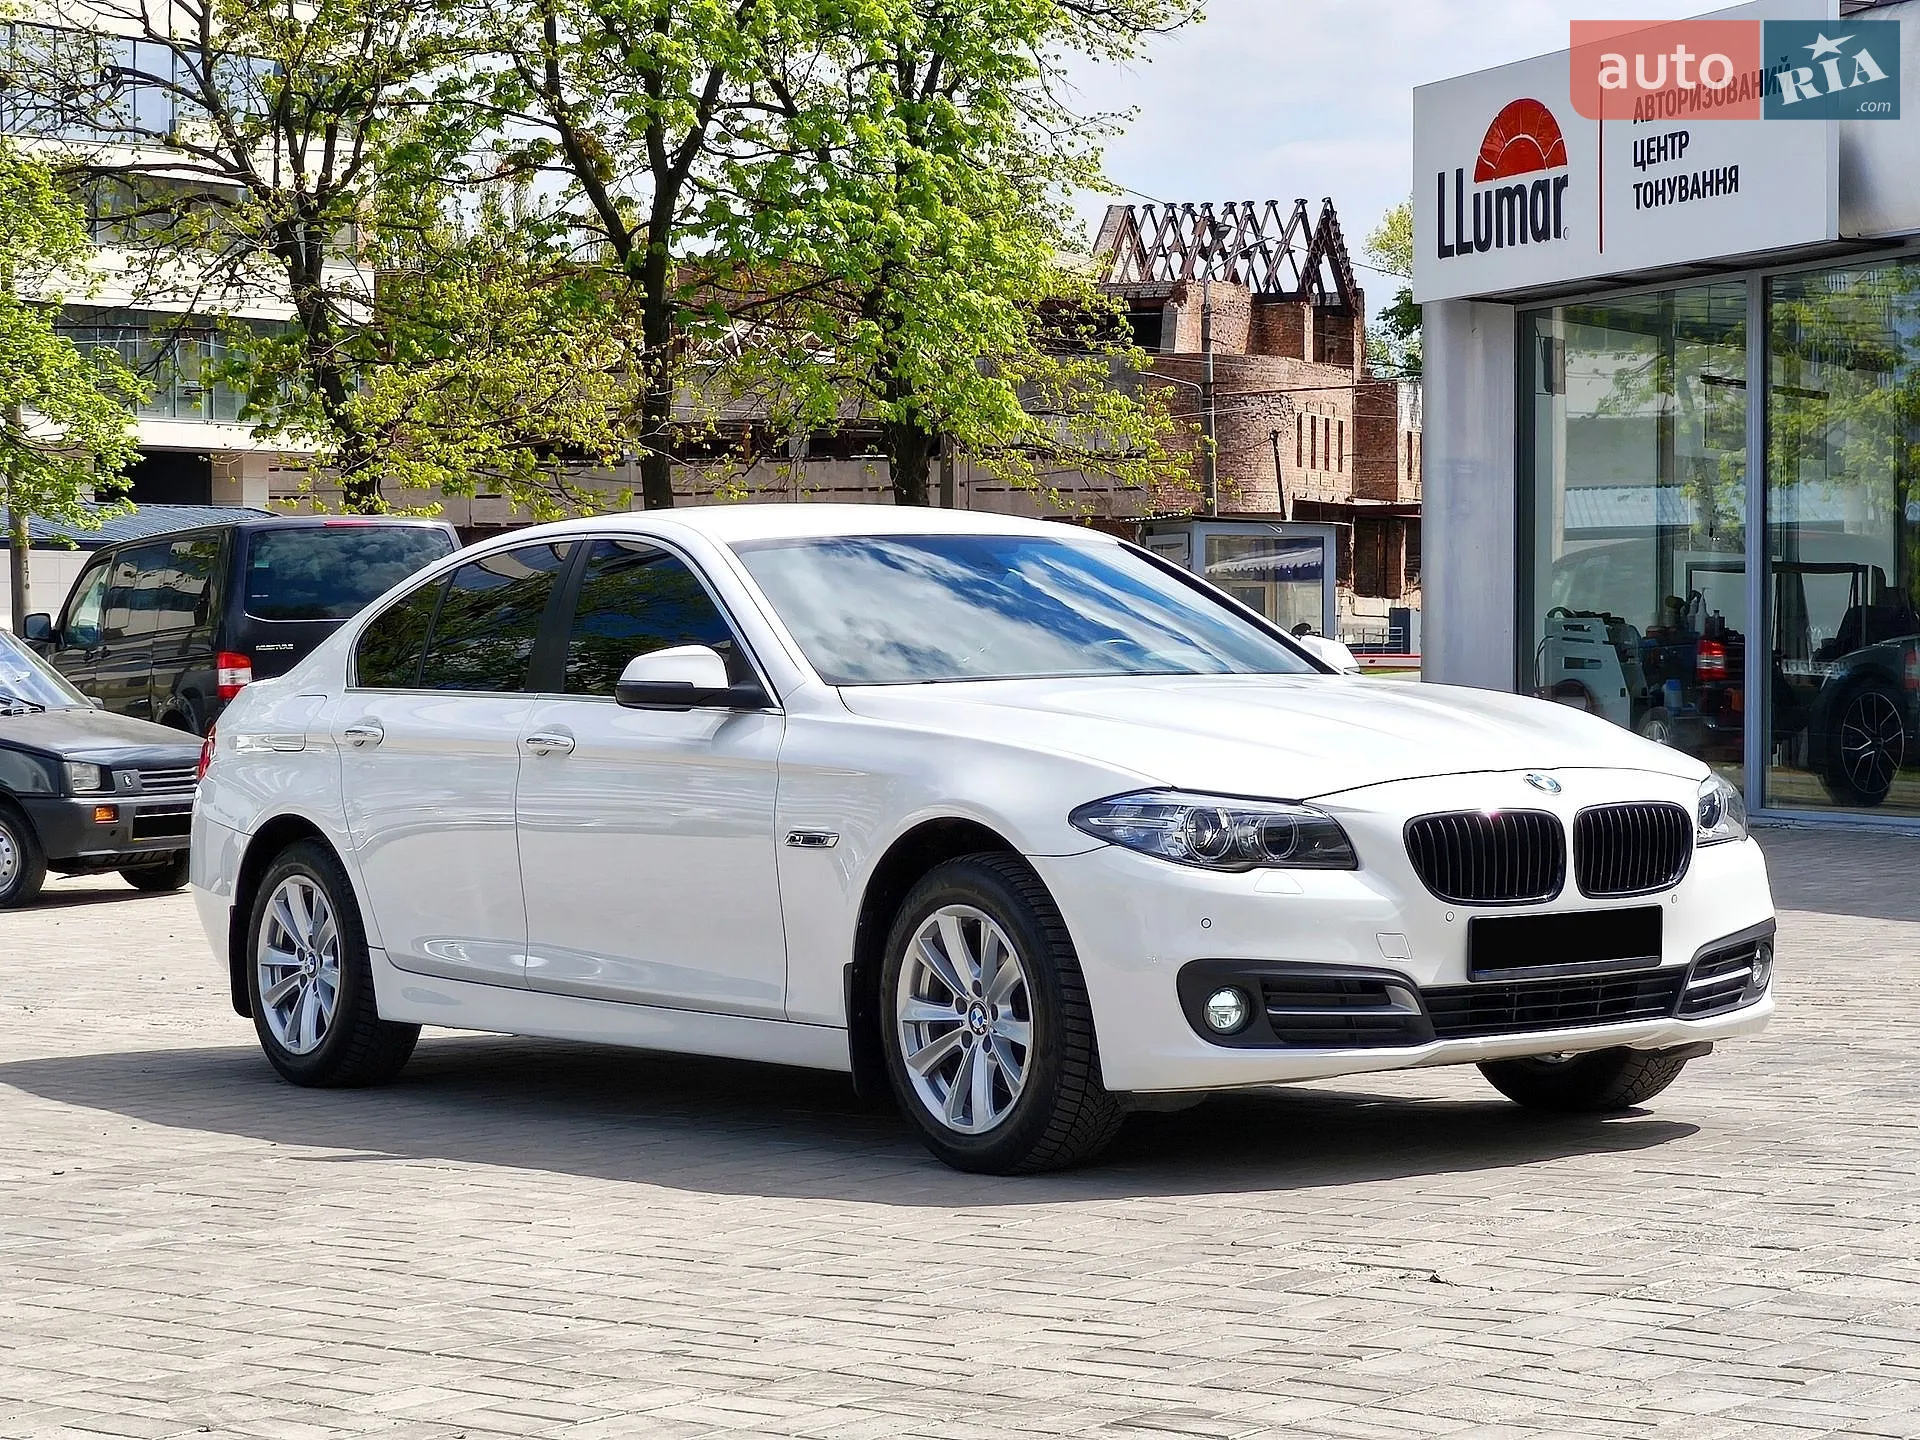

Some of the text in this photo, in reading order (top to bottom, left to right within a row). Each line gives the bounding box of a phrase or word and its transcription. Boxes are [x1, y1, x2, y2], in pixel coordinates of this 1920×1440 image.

[1633, 130, 1690, 172] ЦЕНТР
[1632, 164, 1740, 210] ТОНУВАННЯ
[1437, 167, 1569, 260] LLumar
